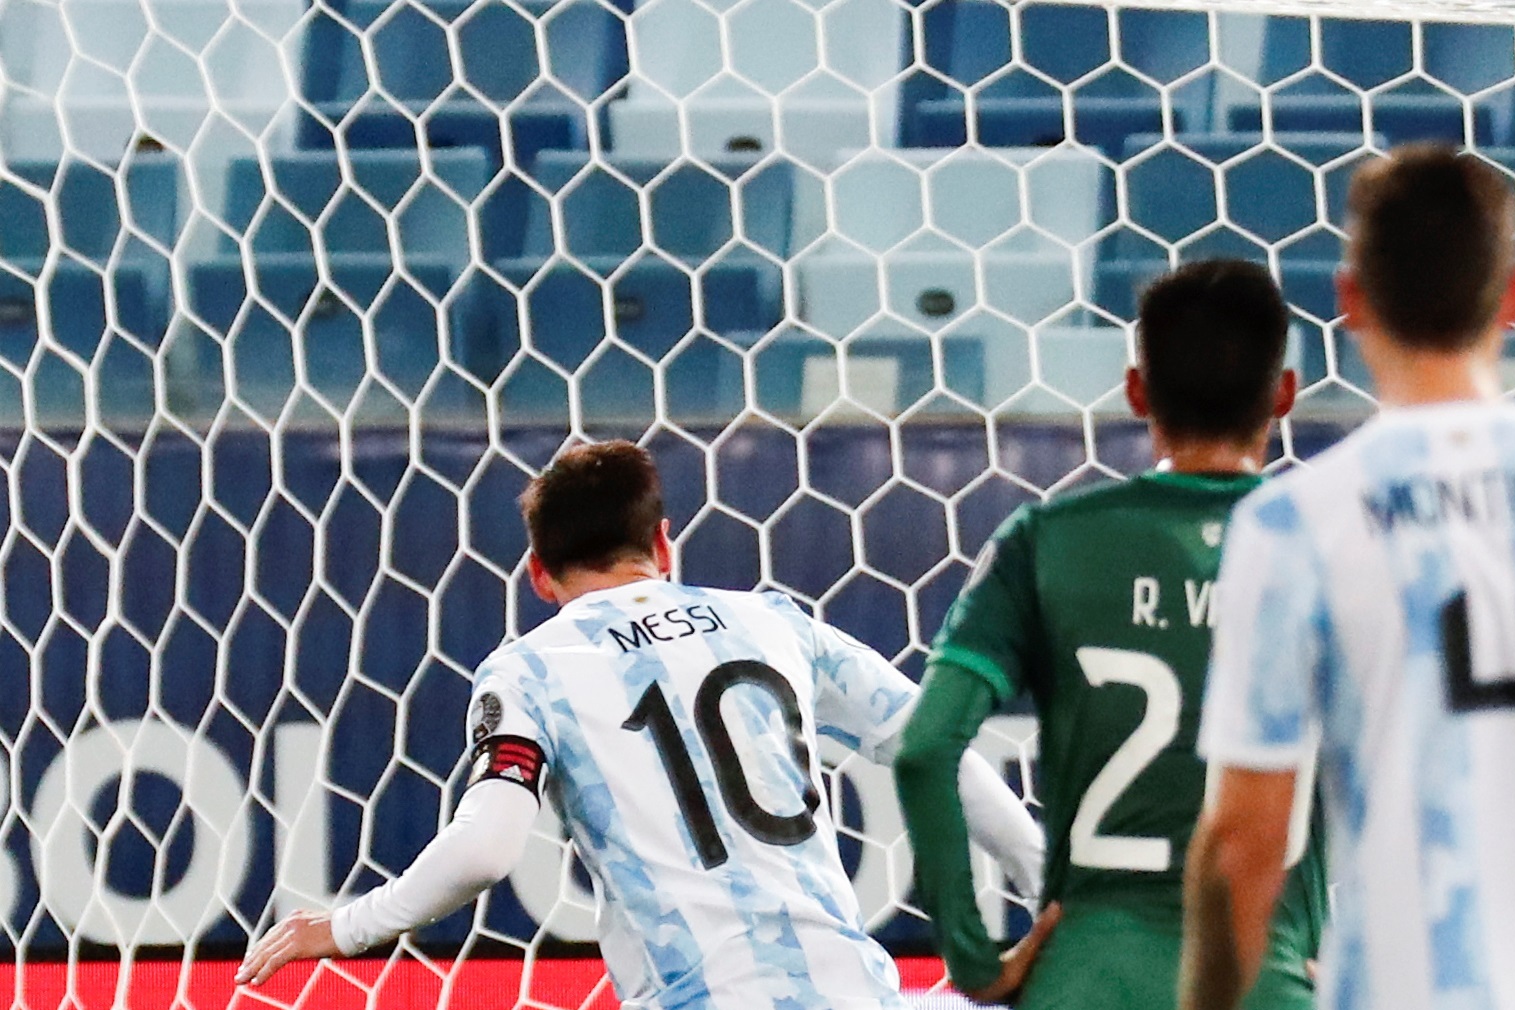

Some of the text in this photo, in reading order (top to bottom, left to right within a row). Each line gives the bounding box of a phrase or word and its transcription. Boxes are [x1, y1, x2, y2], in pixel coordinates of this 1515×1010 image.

[608, 605, 728, 653] MESSI
[1132, 575, 1170, 630] R.
[0, 715, 378, 948] OL
[620, 658, 821, 871] 10
